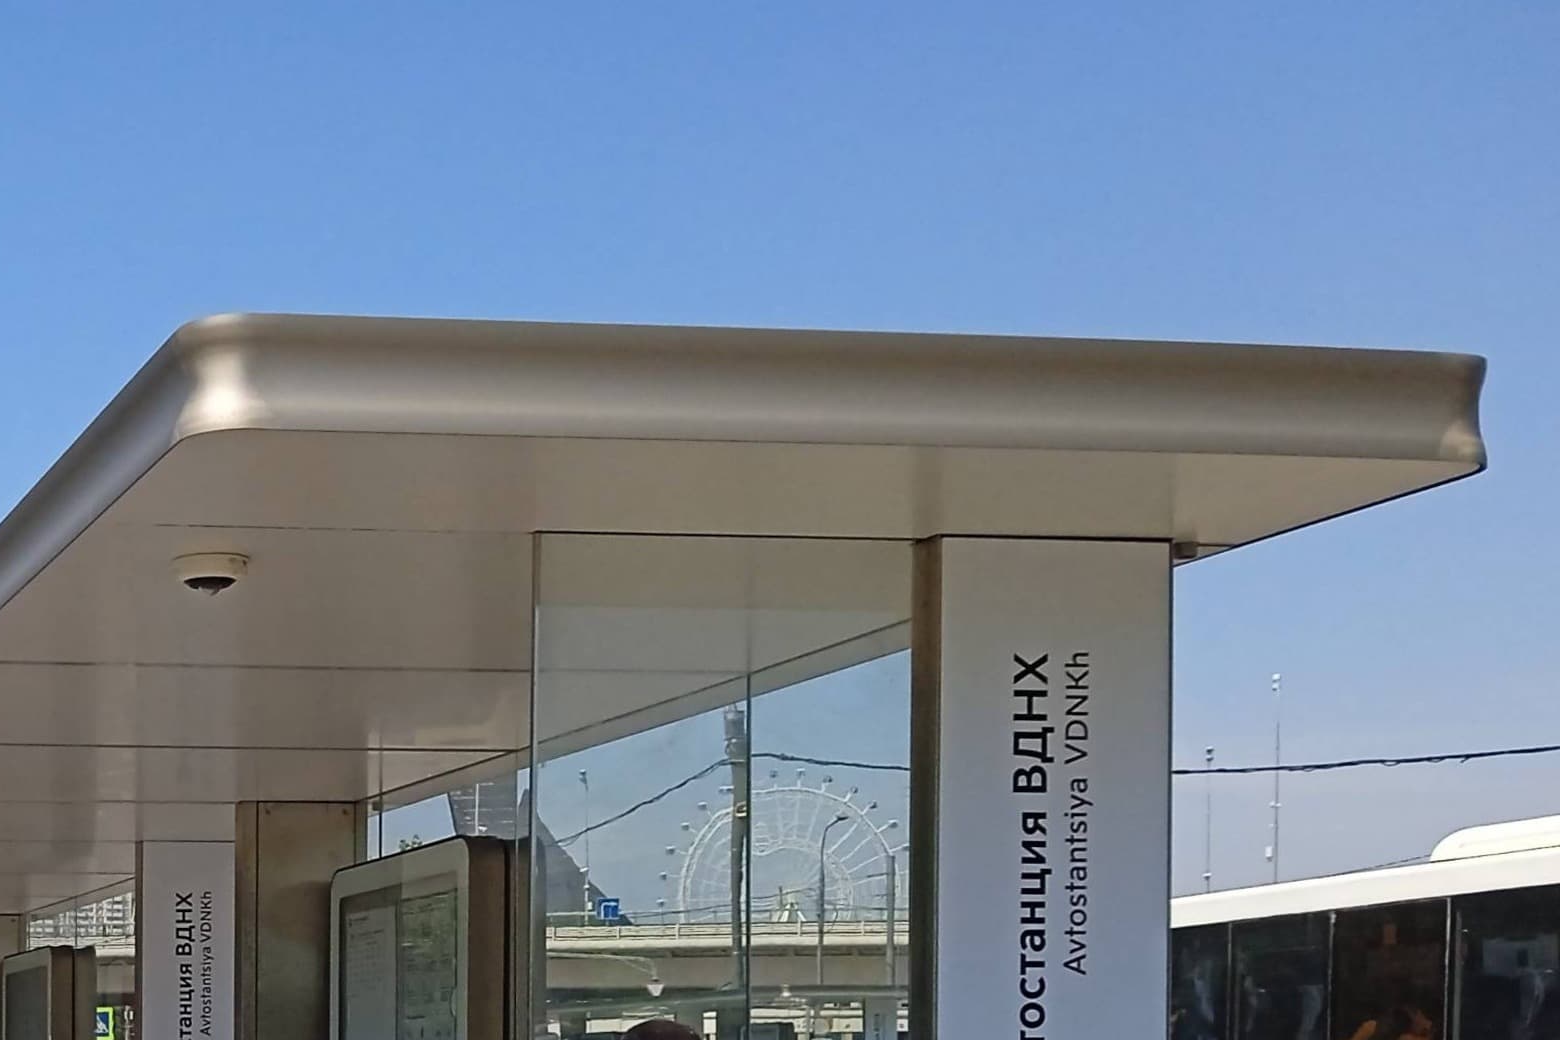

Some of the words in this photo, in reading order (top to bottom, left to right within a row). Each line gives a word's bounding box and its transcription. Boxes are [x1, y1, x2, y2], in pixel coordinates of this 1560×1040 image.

[1012, 653, 1054, 795] ВДНХ
[1064, 651, 1090, 765] VDNKh
[175, 892, 195, 956] ВДНХ
[200, 891, 212, 943] VDNKh
[1063, 777, 1094, 976] Avtostantsiya
[200, 946, 214, 1036] Avtostantsiya
